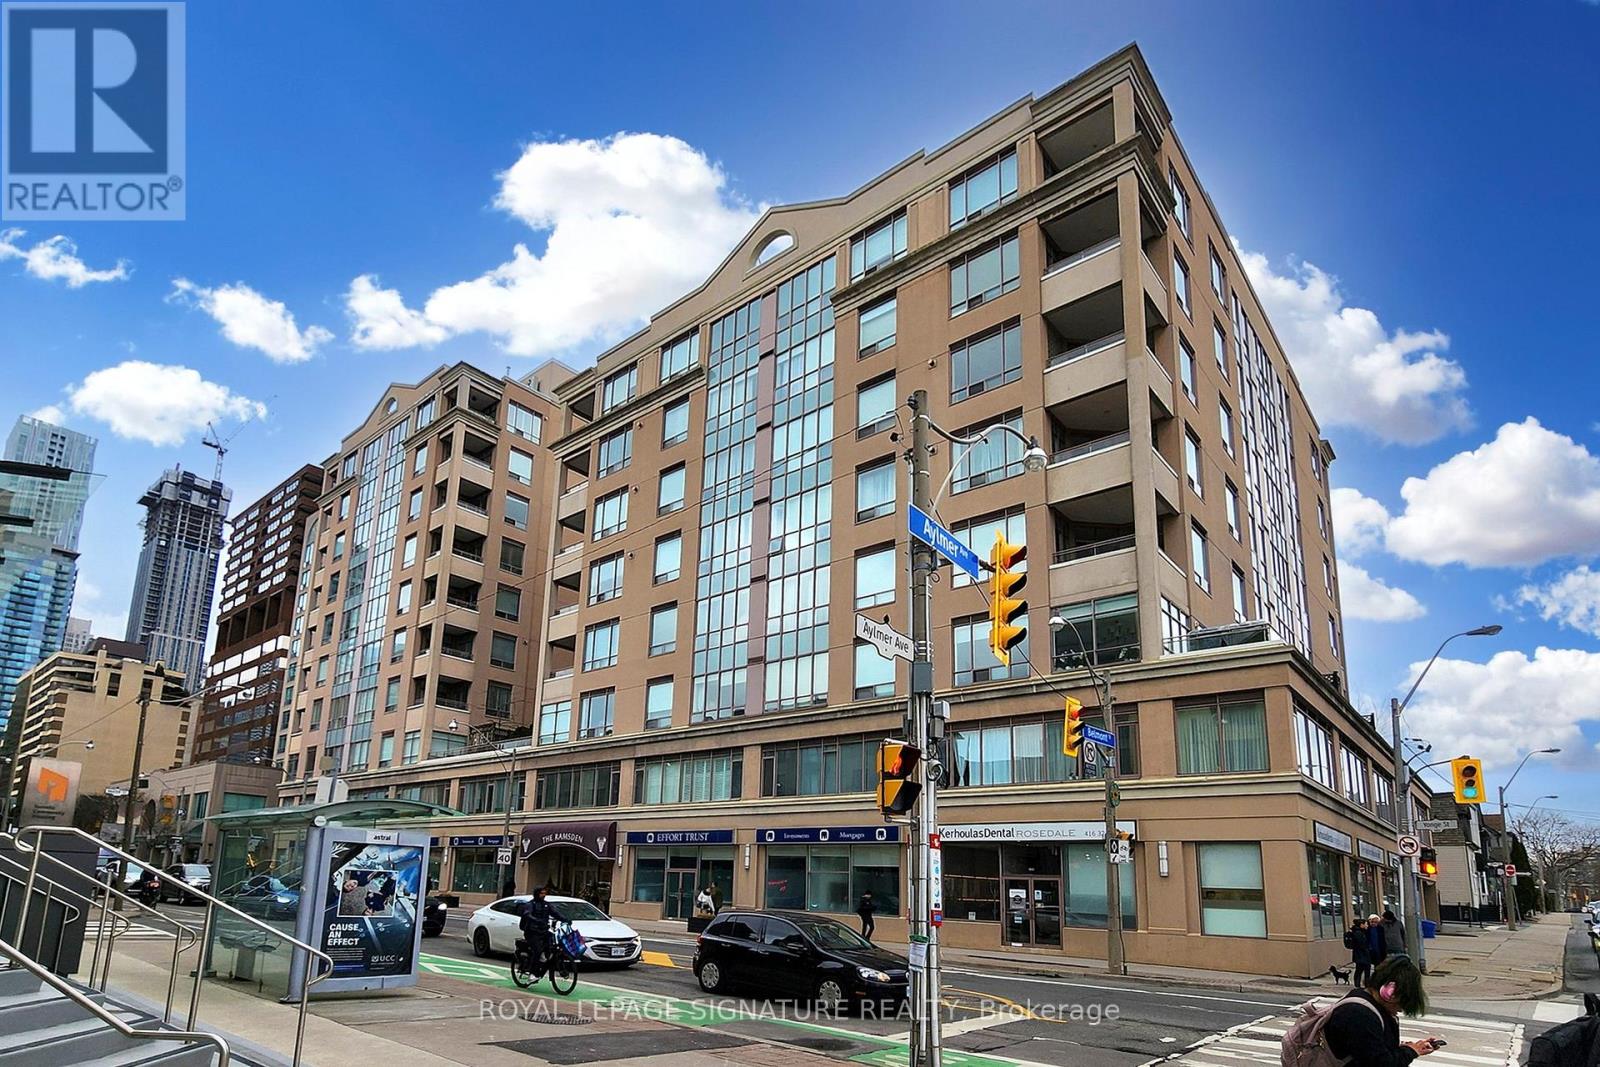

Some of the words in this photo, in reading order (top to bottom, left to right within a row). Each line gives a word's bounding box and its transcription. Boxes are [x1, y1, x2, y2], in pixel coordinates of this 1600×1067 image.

[923, 518, 959, 558] Aylmer
[960, 546, 969, 559] Ave
[863, 621, 893, 646] Aylmer
[895, 636, 909, 653] Ave
[1087, 727, 1108, 742] Belmont
[657, 833, 683, 842] EFFORT
[685, 832, 710, 841] TRUST
[1016, 829, 1076, 838] ROSEDALE
[542, 835, 554, 844] THE
[554, 833, 584, 844] RAMSDEN
[498, 854, 510, 863] 40
[329, 923, 359, 931] CAUSE
[328, 931, 342, 939] AN
[327, 938, 360, 946] EFFECT
[379, 954, 396, 962] UCC
